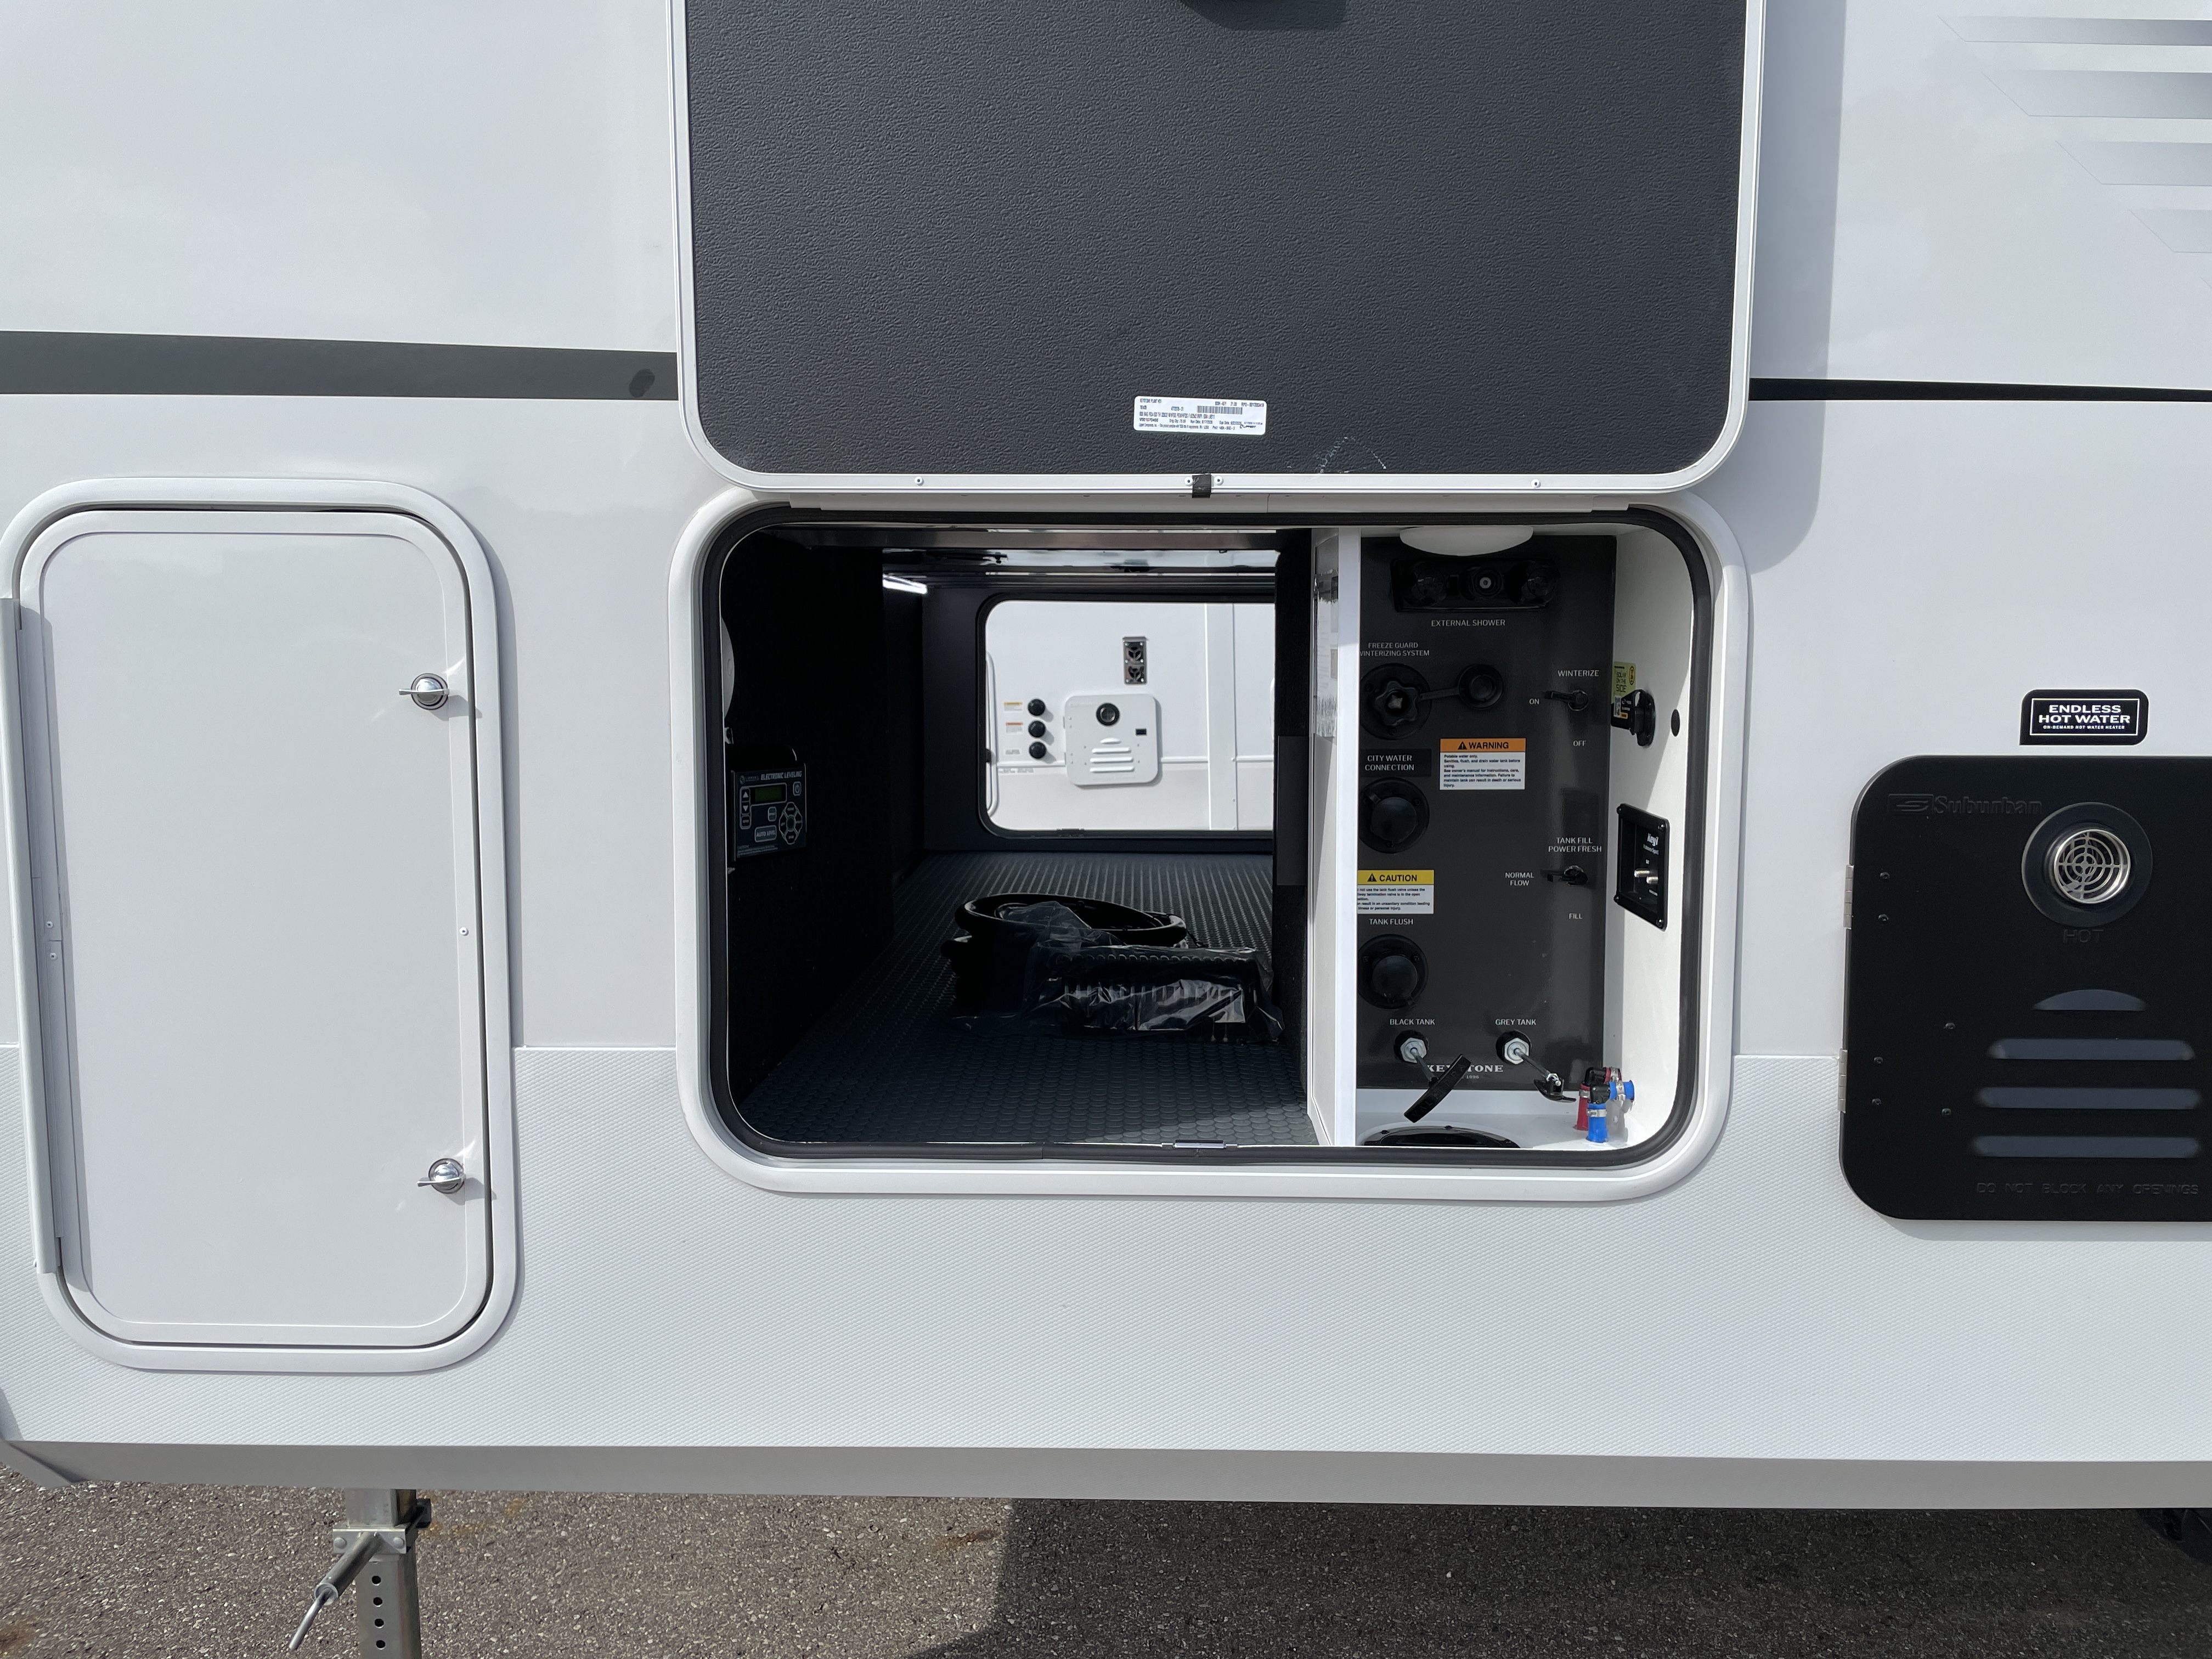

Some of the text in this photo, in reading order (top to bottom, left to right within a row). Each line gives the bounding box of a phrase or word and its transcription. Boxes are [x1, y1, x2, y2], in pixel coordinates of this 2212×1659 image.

[1616, 684, 1627, 693] SIDE
[2049, 705, 2121, 713] ENDLESS
[2039, 715, 2130, 723] HOT WATER
[1934, 796, 2042, 814] Suburban
[2063, 929, 2104, 944] HOT
[1427, 1064, 1504, 1073] KETONE
[1977, 1183, 2199, 1195] DO NOT BLOCK ANY OPENINGS
